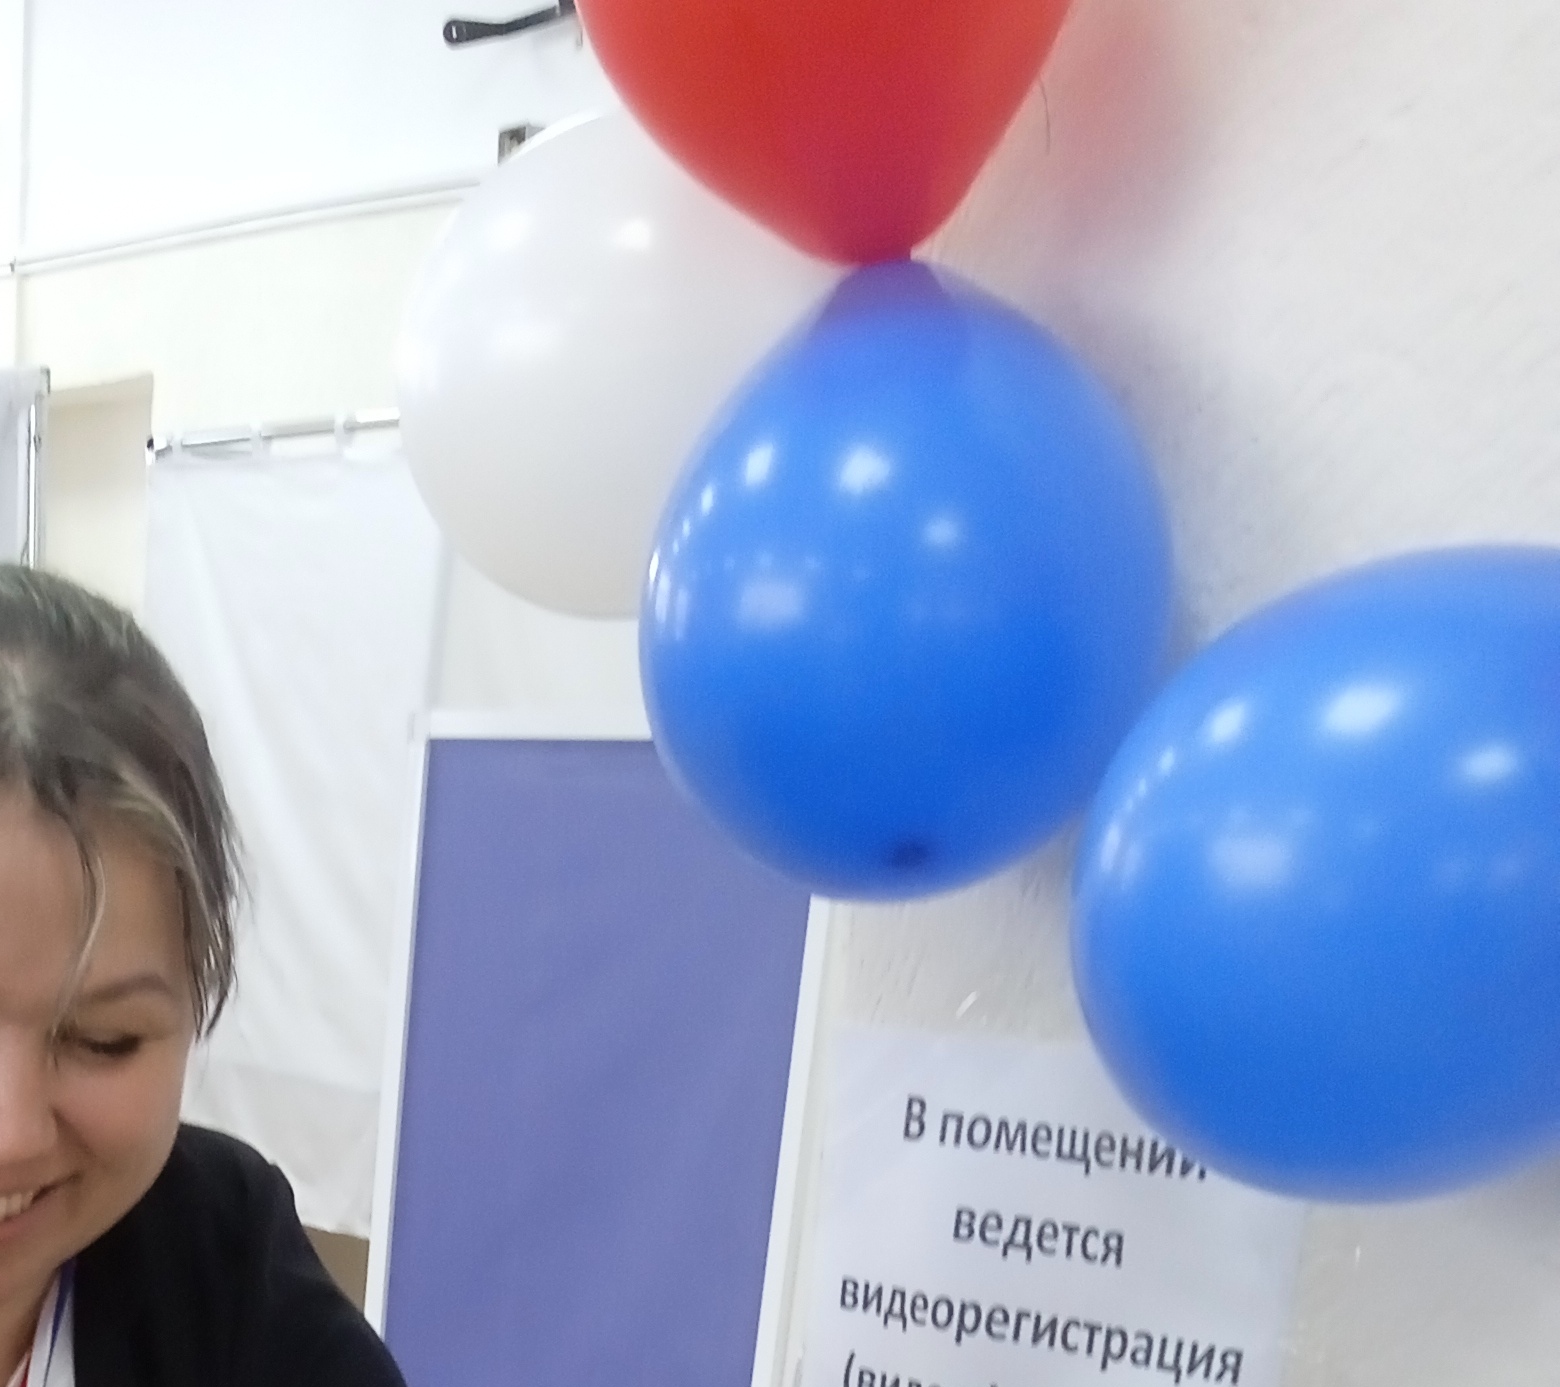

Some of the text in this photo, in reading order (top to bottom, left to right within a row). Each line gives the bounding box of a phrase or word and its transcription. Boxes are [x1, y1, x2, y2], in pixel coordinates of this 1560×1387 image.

[902, 1096, 926, 1142] В
[952, 1206, 1125, 1267] ведется
[840, 1276, 1244, 1387] видеорегистрация
